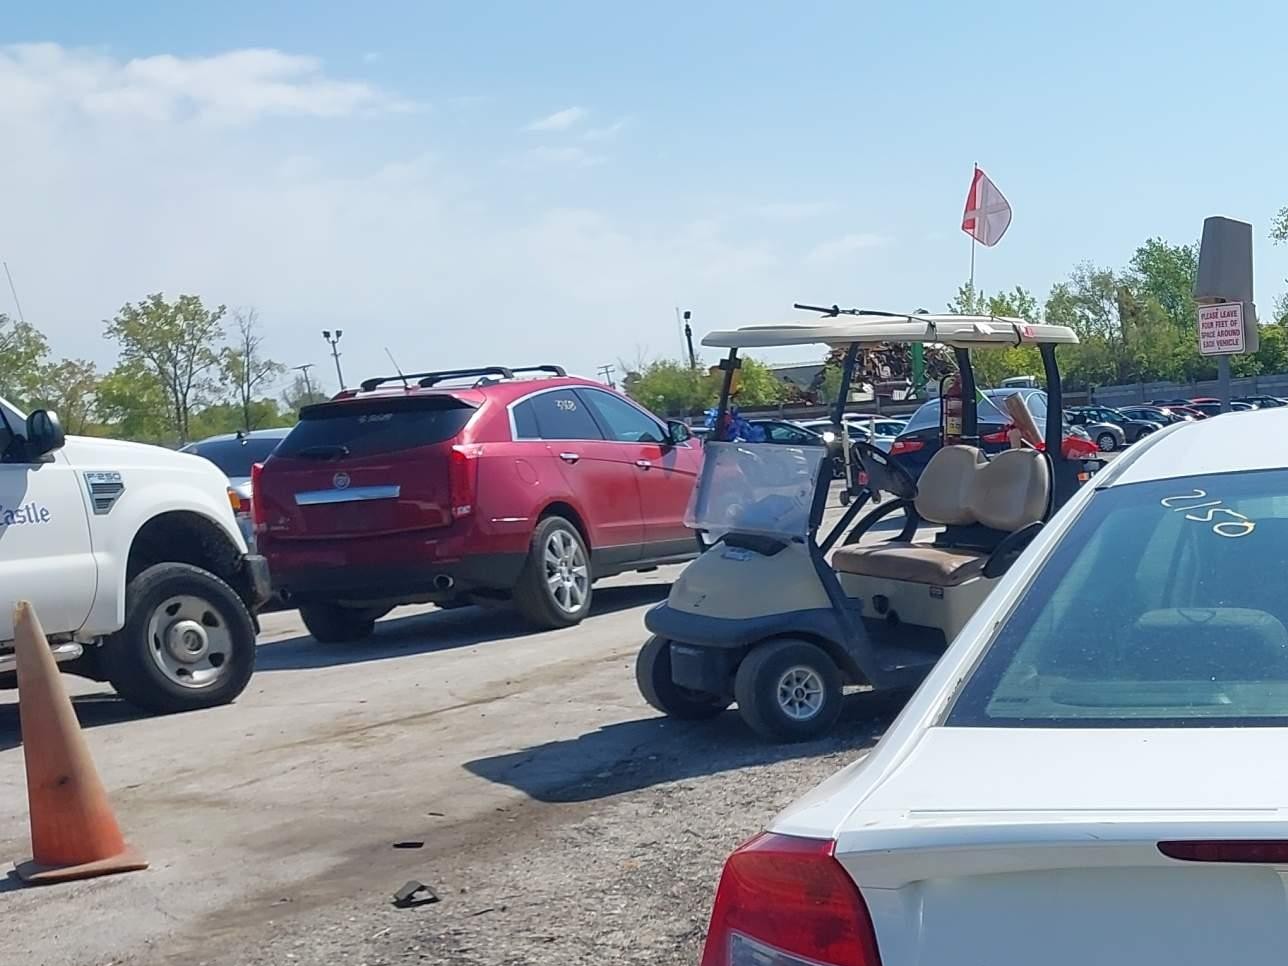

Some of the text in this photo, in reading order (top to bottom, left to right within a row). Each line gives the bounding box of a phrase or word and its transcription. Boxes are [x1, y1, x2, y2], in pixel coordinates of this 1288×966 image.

[1201, 310, 1238, 320] PLEASE LEAVE
[1216, 320, 1228, 328] FEET
[1201, 329, 1240, 339] SPACE AROUND
[1203, 338, 1239, 348] EACH VEHICLE
[86, 472, 121, 481] F-250
[1160, 488, 1256, 537] 2150
